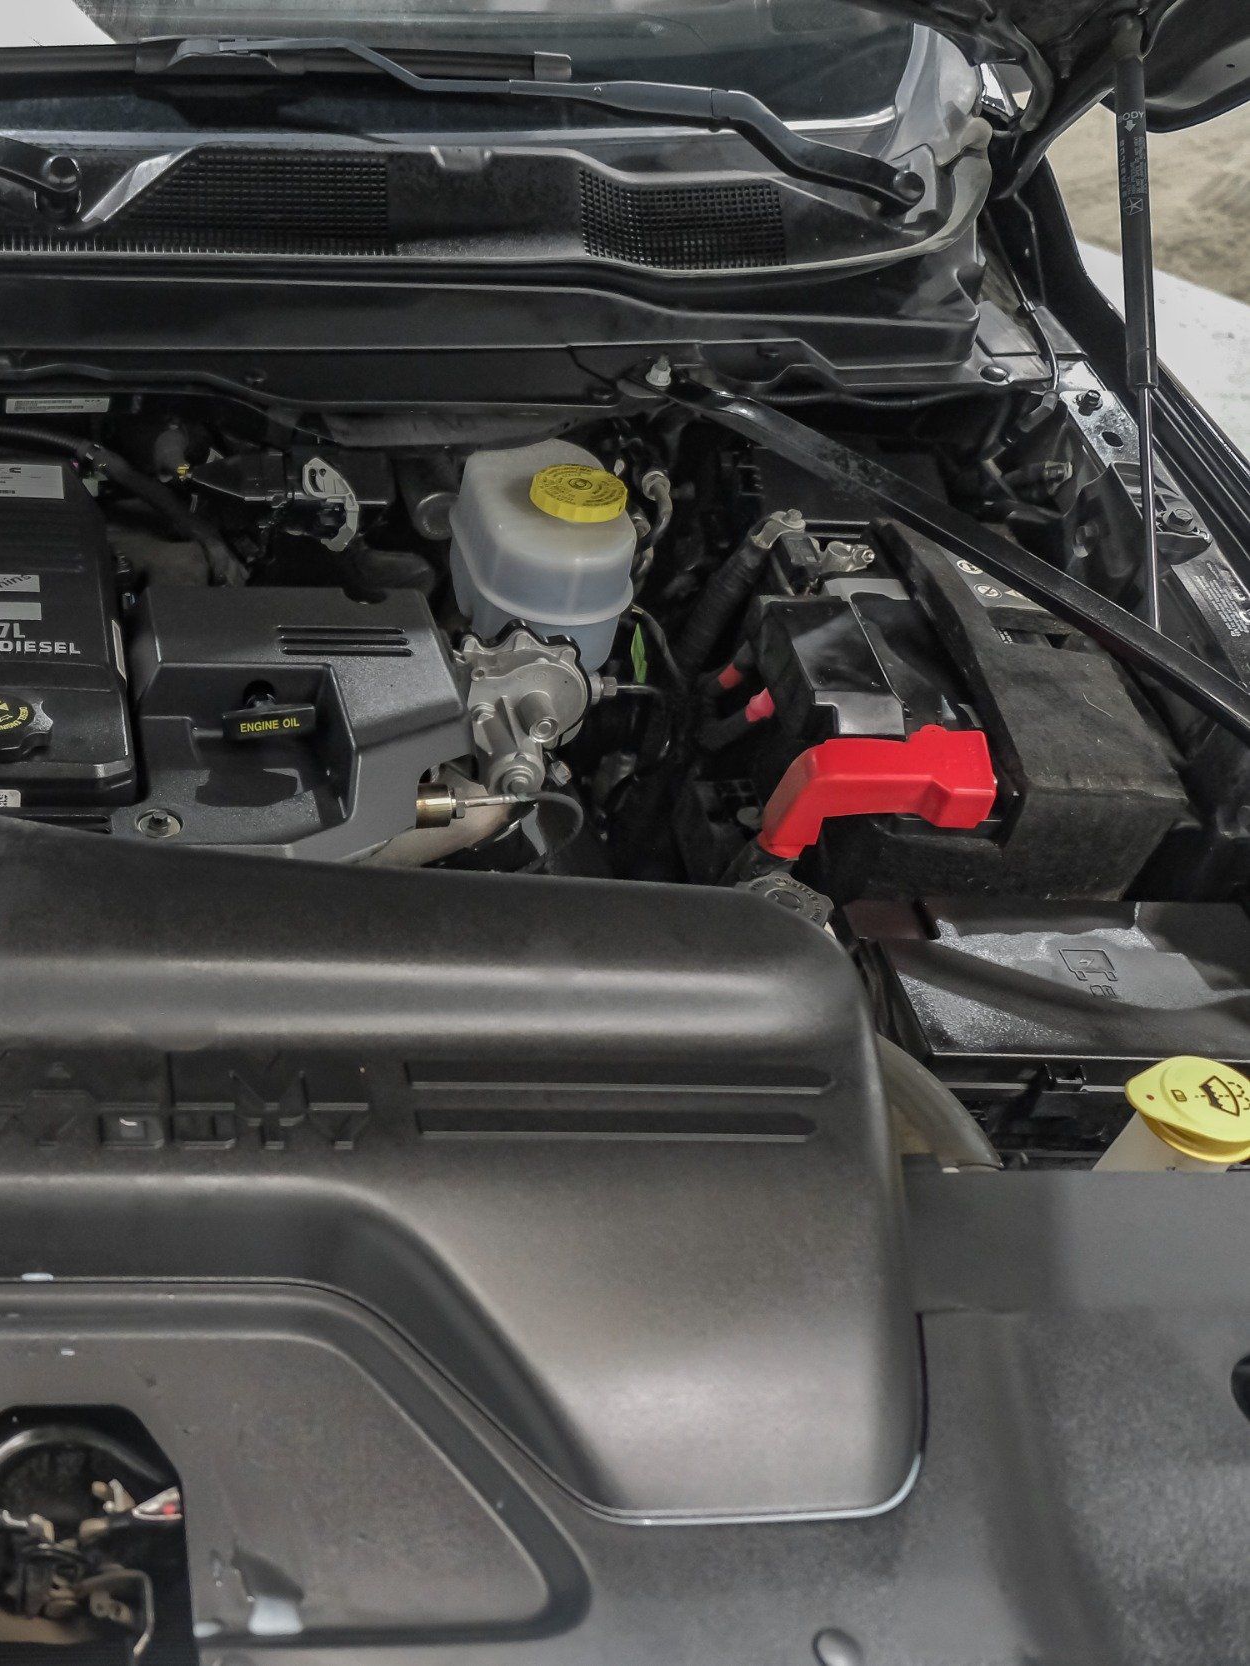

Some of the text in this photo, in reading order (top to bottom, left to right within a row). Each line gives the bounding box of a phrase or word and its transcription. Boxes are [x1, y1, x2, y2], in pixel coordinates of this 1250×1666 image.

[1118, 111, 1143, 123] BODY
[0, 640, 81, 655] DIESEL
[239, 717, 300, 733] ENGINE OIL
